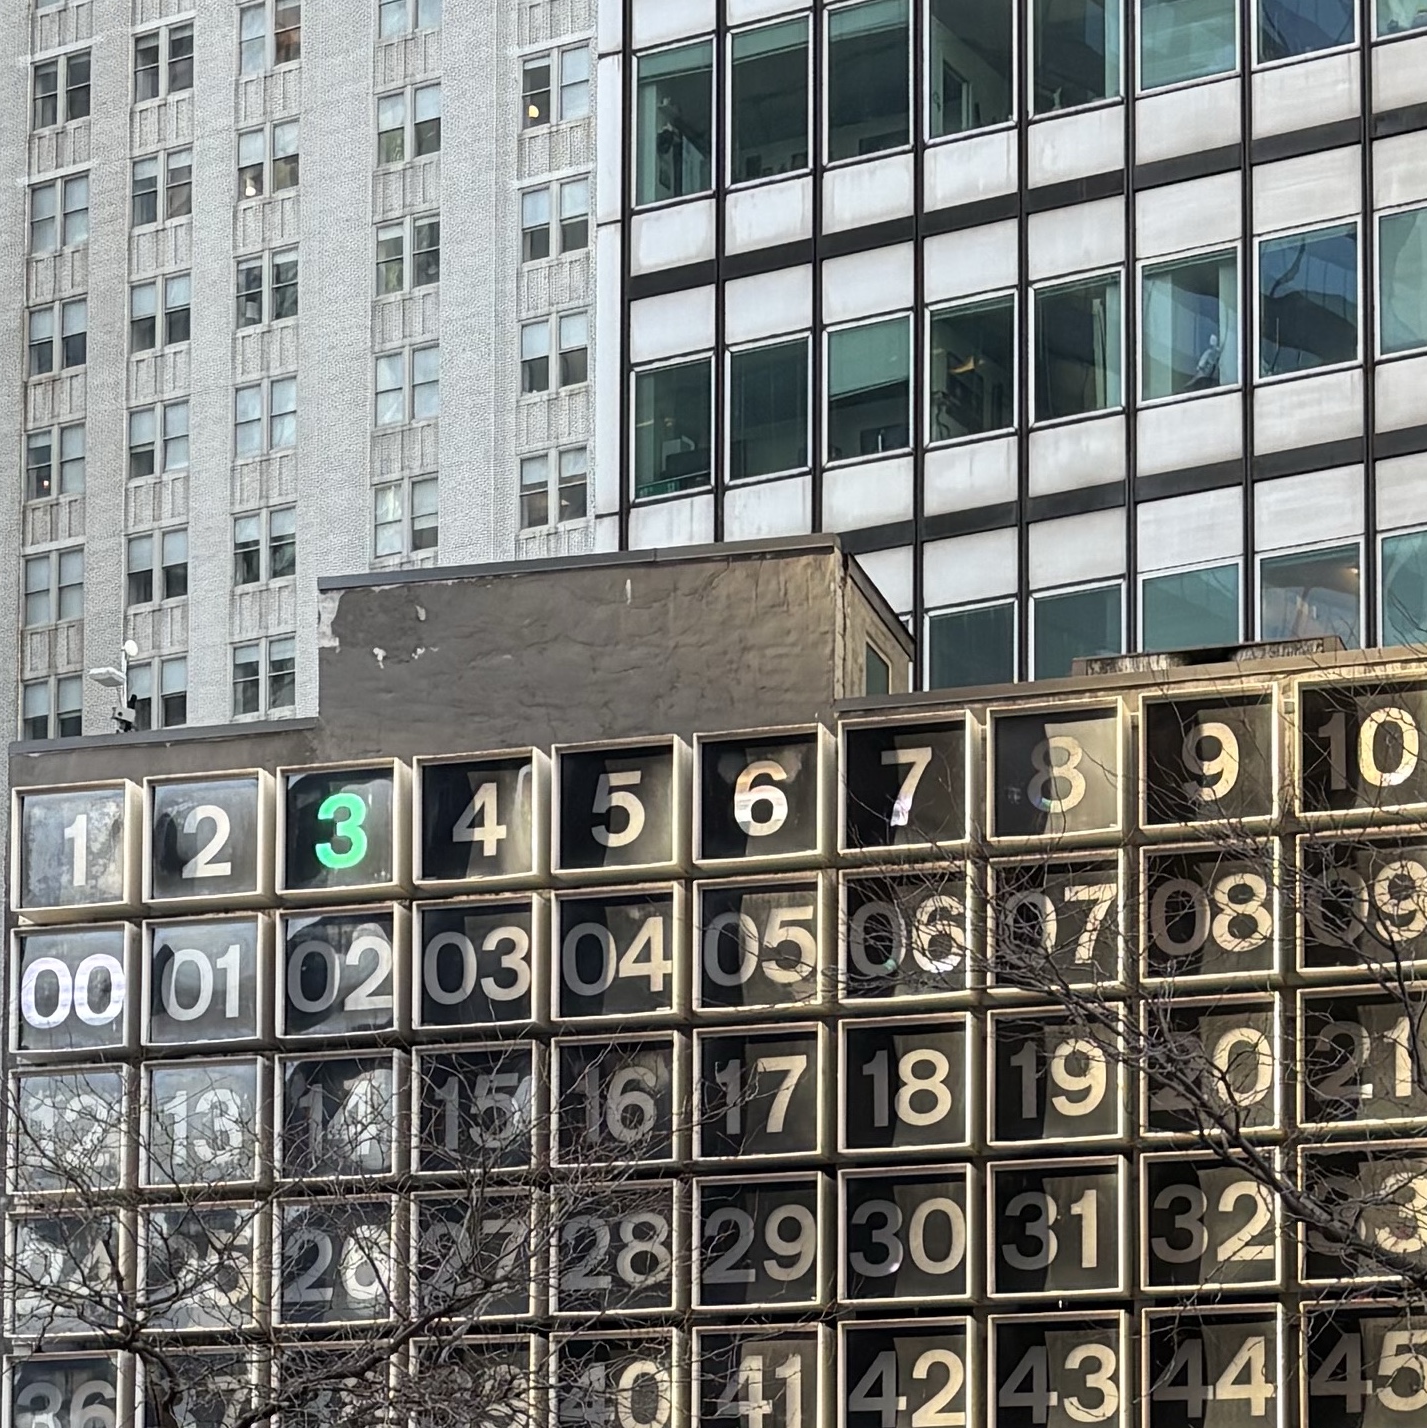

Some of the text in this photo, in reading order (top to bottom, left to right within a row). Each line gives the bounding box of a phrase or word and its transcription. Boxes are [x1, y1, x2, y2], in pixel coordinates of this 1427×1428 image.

[63, 814, 89, 886] 1
[182, 805, 232, 879] 2
[315, 793, 368, 869] 3
[452, 783, 508, 857] 4
[591, 771, 646, 848] 5
[734, 760, 789, 836] 6
[881, 747, 933, 827] 7
[1027, 735, 1086, 813] 8
[1181, 722, 1239, 800] 9
[1317, 706, 1418, 791] 10
[21, 954, 125, 1029] 00
[160, 945, 242, 1022] 01
[287, 935, 393, 1013] 02
[423, 928, 532, 1006] 03
[561, 916, 672, 998] 04
[703, 907, 817, 987] 05
[850, 895, 964, 977] 06
[1005, 882, 1117, 966] 07
[1150, 872, 1273, 955] 08
[163, 1088, 243, 1163] 13
[299, 1071, 384, 1168] 14
[434, 1073, 531, 1152] 15
[578, 1065, 658, 1143] 16
[715, 1055, 807, 1134] 17
[863, 1050, 952, 1126] 18
[1011, 1038, 1107, 1119] 19
[1318, 1015, 1414, 1100] 21
[284, 1225, 389, 1303] 26
[559, 1212, 672, 1289] 28
[703, 1204, 817, 1284] 29
[850, 1198, 964, 1277] 30
[1002, 1189, 1098, 1271] 31
[1153, 1181, 1275, 1263] 32
[850, 1349, 966, 1428] 42
[1000, 1343, 1117, 1423] 43
[1153, 1336, 1275, 1417] 44
